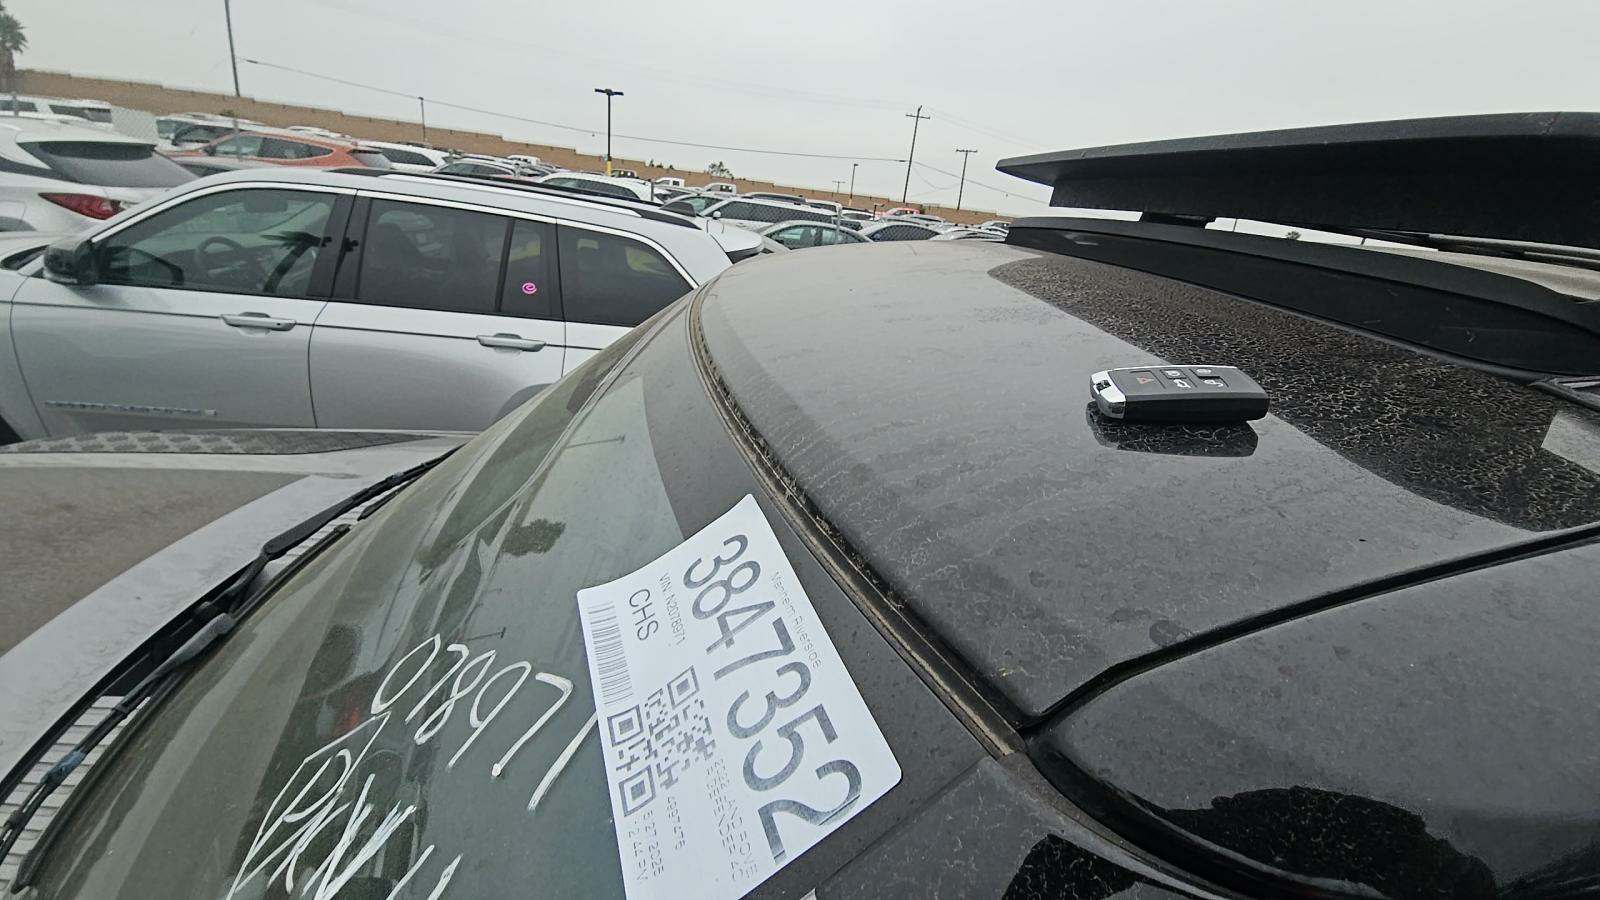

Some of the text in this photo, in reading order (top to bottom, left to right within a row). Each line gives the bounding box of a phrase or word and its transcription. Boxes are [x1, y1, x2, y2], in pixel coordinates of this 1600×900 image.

[629, 588, 659, 641] CHS
[793, 615, 822, 669] Riverside
[682, 534, 863, 864] 3847352
